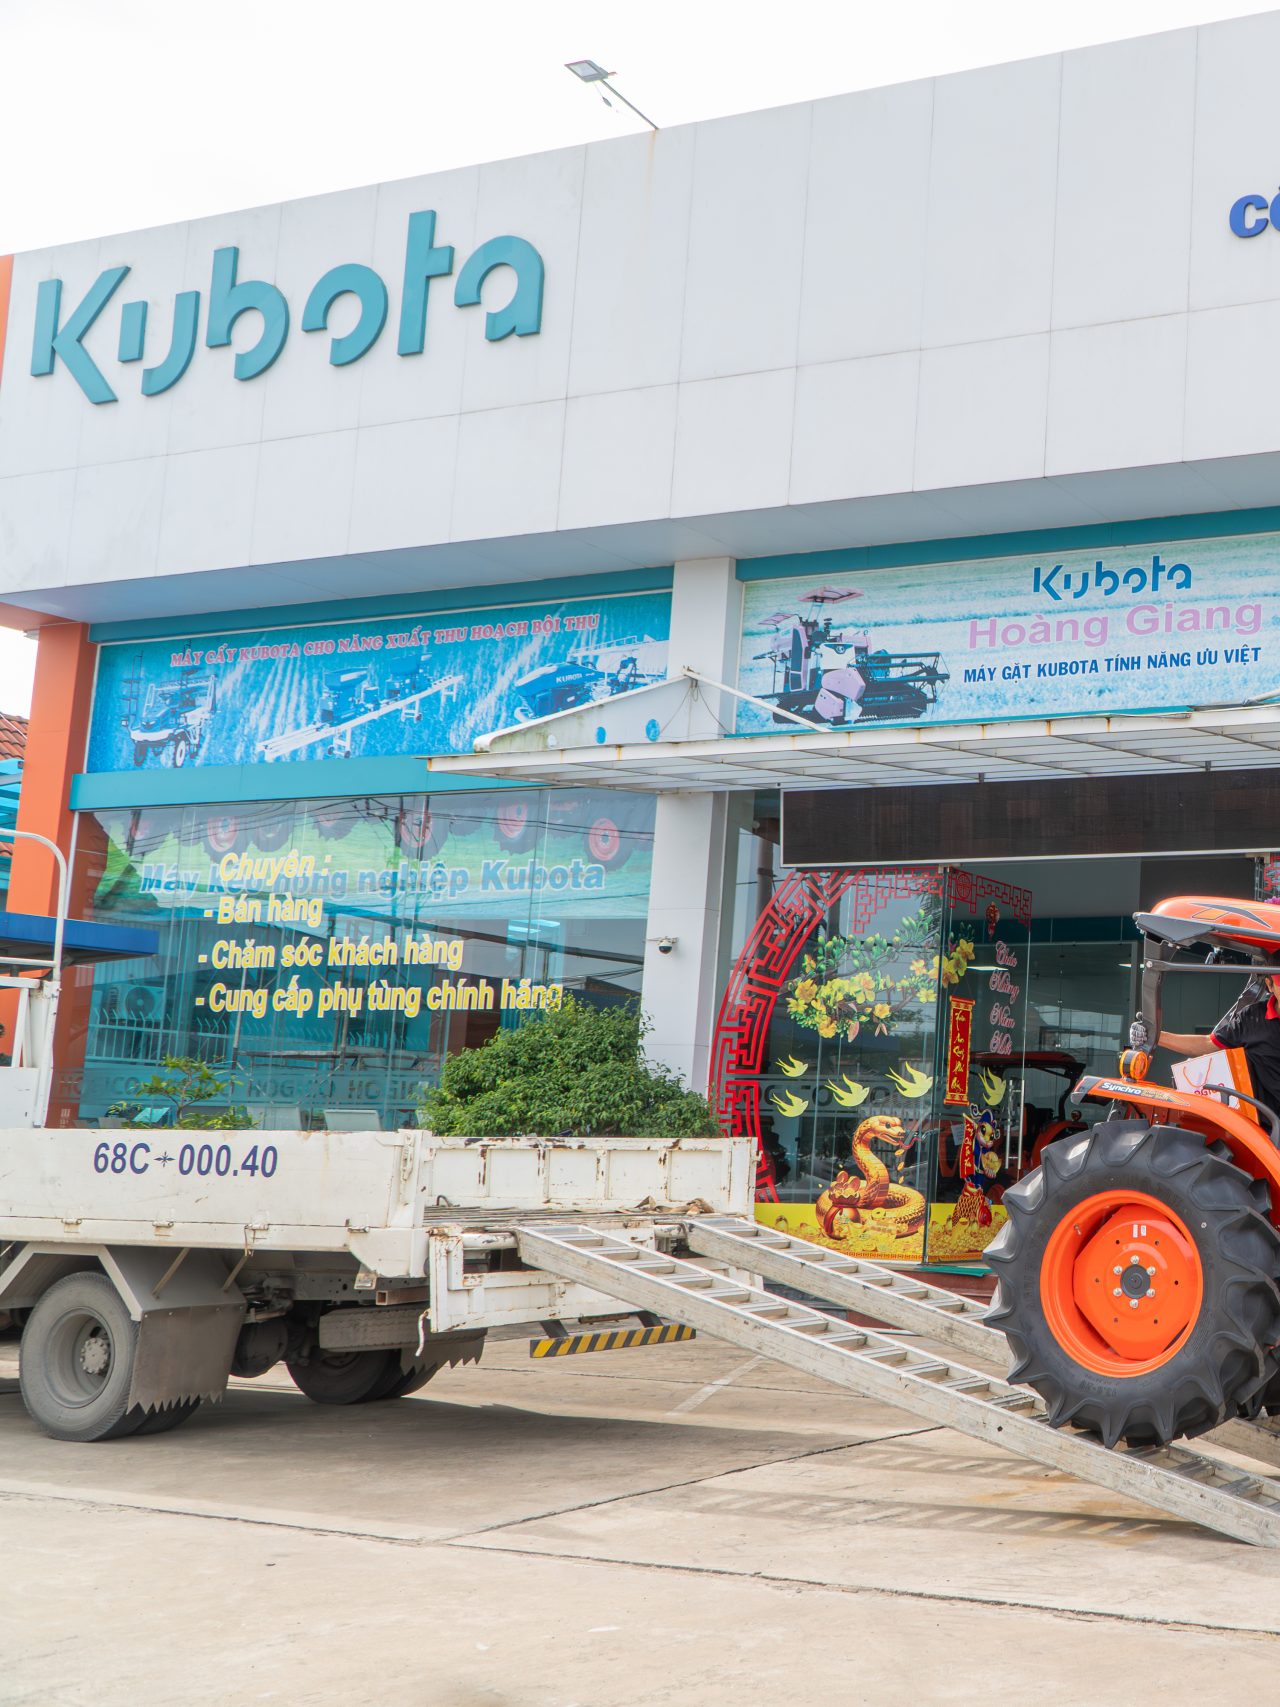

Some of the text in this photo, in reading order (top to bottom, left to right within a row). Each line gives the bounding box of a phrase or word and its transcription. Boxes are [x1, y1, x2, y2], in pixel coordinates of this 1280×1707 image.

[31, 209, 545, 404] Kubota
[1032, 555, 1192, 601] Kubota
[170, 614, 600, 667] MÁY CẤY KUBOTA CHO NĂNG XUẤT THU HOẠCH BỘI THU
[968, 602, 1262, 649] Hoàng Giang
[963, 643, 1262, 684] MÁY GẶT KUBOTA TÍNH NĂNG ƯU VIỆT
[139, 863, 200, 900] Máy
[357, 859, 470, 899] nghiệp
[480, 859, 606, 892] Kubota
[220, 848, 316, 886] Chuyên
[217, 894, 261, 924] Bán
[268, 892, 323, 928] hàng
[212, 939, 275, 969] Chăm
[280, 937, 323, 967] sóc
[327, 935, 398, 966] khách
[404, 934, 464, 971] hàng
[209, 982, 268, 1018] Cung
[273, 975, 314, 1018] cấp
[317, 981, 363, 1018] phụ
[368, 979, 421, 1018] tùng
[427, 979, 494, 1010] chính
[1101, 1082, 1142, 1096] Synchro
